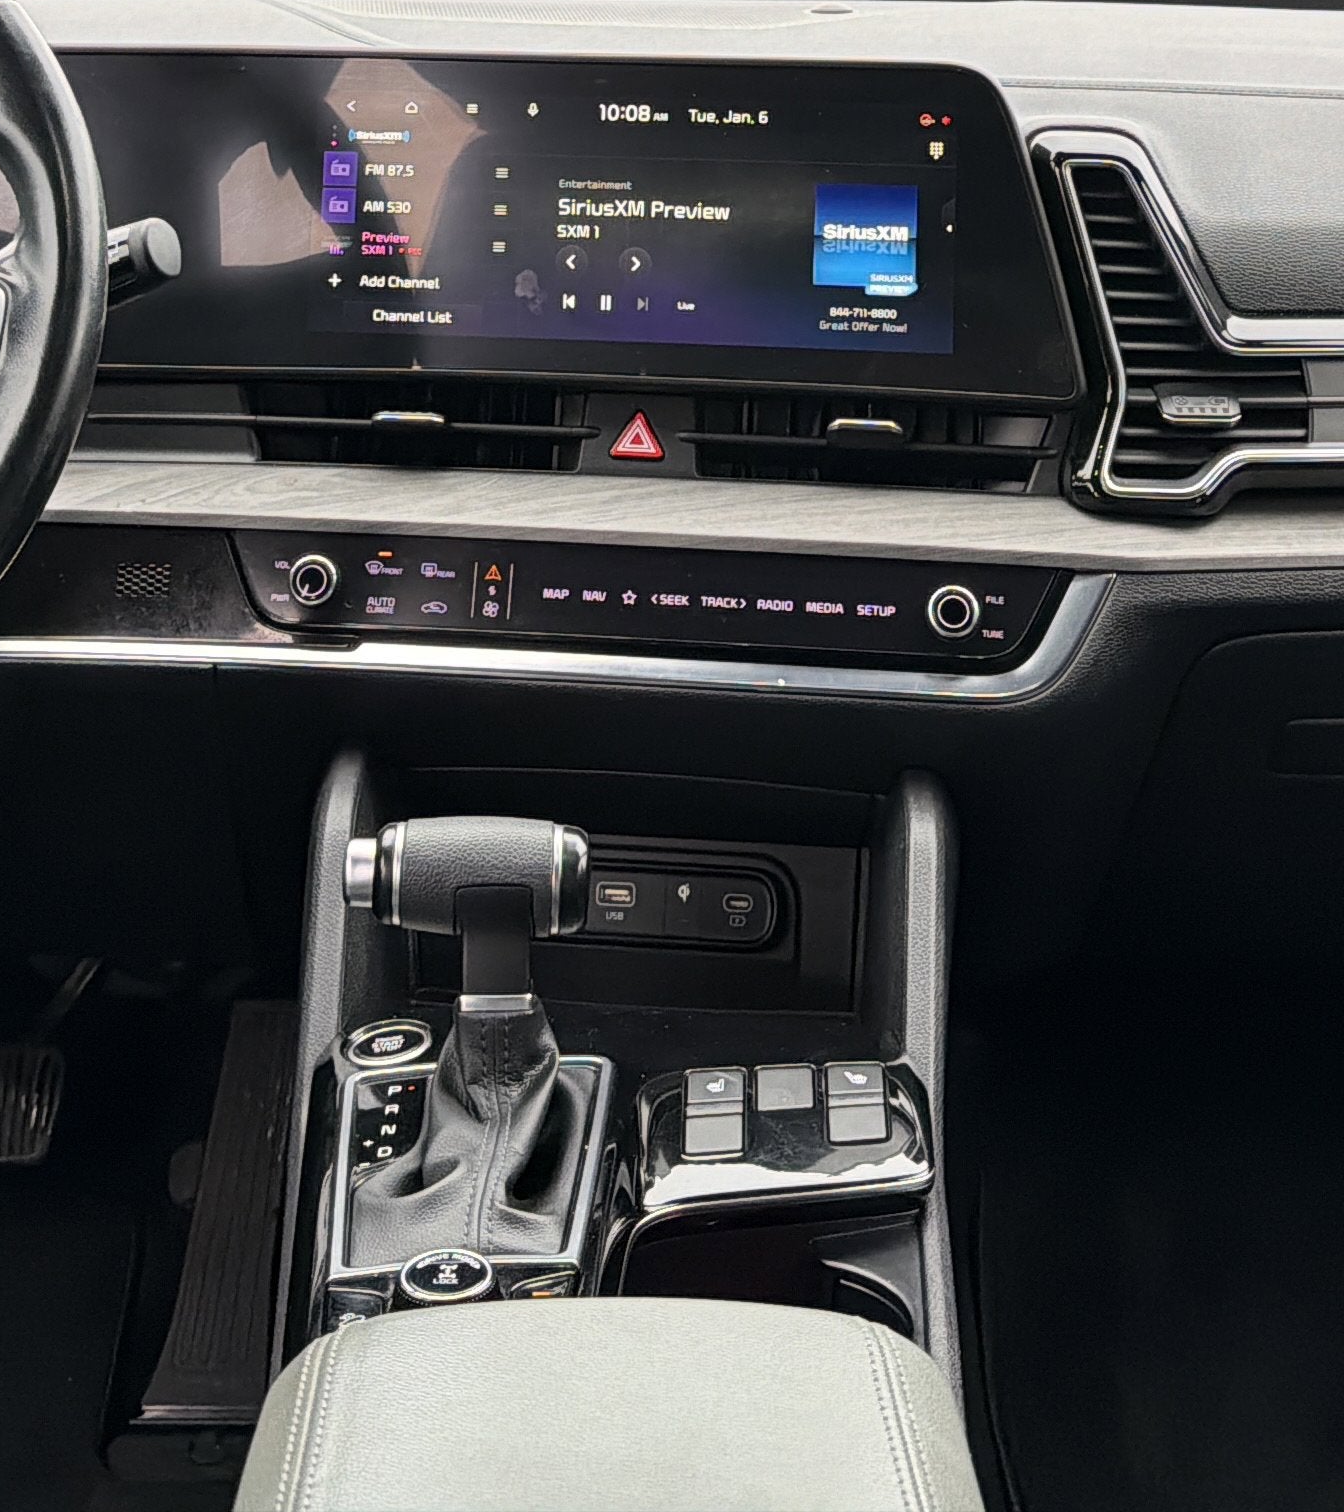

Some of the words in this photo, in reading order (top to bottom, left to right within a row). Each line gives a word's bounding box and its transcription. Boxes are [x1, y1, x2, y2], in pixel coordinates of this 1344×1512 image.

[599, 103, 651, 123] 10:08
[652, 112, 669, 123] AM
[758, 110, 769, 125] 6
[364, 164, 384, 177] FM
[387, 164, 415, 177] 87.5
[558, 178, 633, 191] Entertainment
[362, 201, 384, 213] AM
[386, 201, 412, 214] 530
[558, 198, 645, 218] SiriusXM
[651, 200, 731, 221] Preview
[361, 231, 410, 244] Preview
[556, 224, 590, 238] SXM
[594, 225, 601, 239] 1
[822, 223, 909, 242] SiriusXM
[361, 245, 386, 256] SXM
[359, 275, 385, 288] Add
[387, 275, 441, 290] Channel
[372, 309, 425, 323] Channel
[427, 311, 453, 324] List
[829, 306, 898, 320] 844-711-8800
[819, 320, 850, 331] Great
[851, 321, 878, 332] Offer
[882, 322, 908, 334] Now!
[274, 560, 291, 570] VOL
[380, 567, 404, 576] FRONT
[542, 588, 570, 600] MAP
[582, 589, 607, 602] NAV
[985, 595, 1005, 605] FILE
[366, 596, 396, 607] AUTO
[756, 598, 794, 612] RADIO
[805, 601, 844, 615] MEDIA
[856, 604, 896, 617] SETUP
[981, 629, 1004, 640] TUNE
[605, 911, 624, 921] USB
[387, 1085, 403, 1097] P
[384, 1103, 400, 1116] R
[380, 1124, 397, 1136] N
[376, 1145, 393, 1158] D
